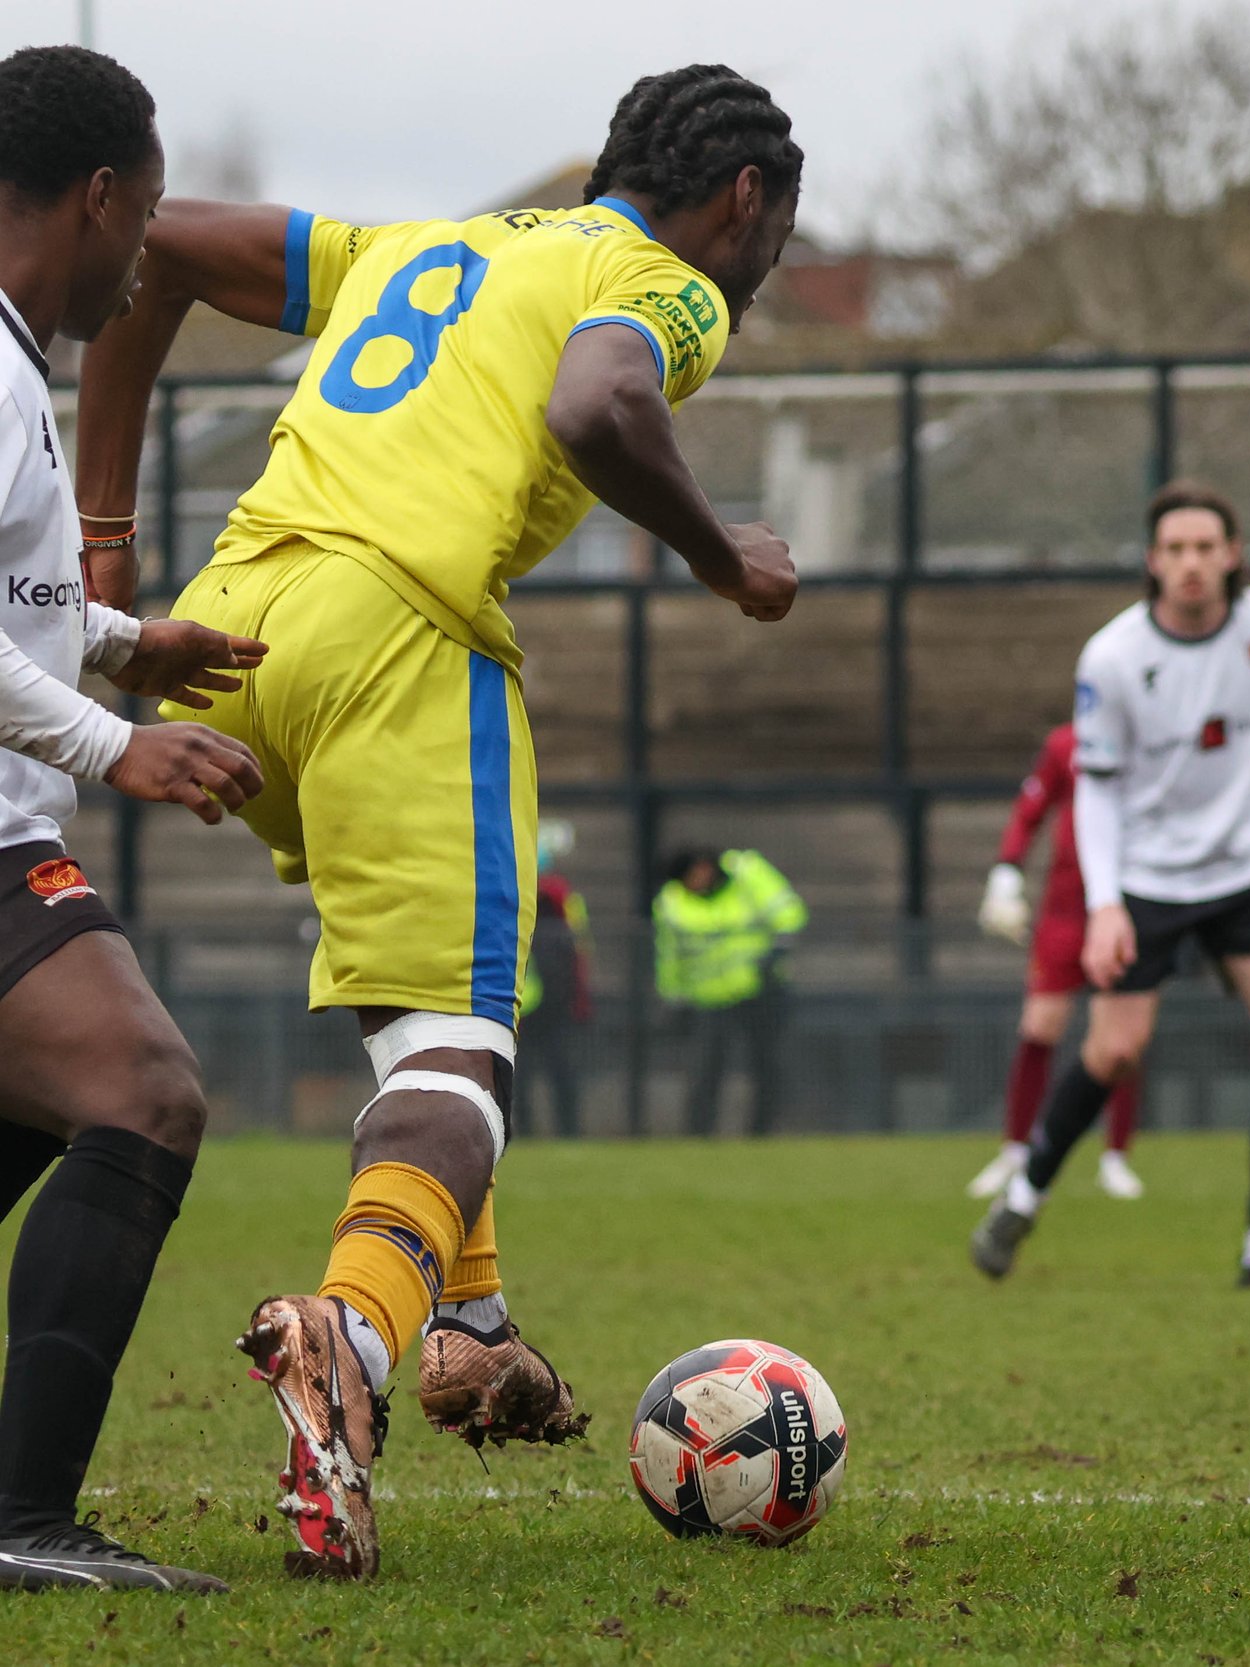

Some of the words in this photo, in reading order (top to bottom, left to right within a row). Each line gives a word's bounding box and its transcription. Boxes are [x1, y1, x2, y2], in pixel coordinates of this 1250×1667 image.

[319, 240, 490, 414] 8
[84, 538, 123, 548] ORGIVEN
[780, 1390, 808, 1500] uhlsport
